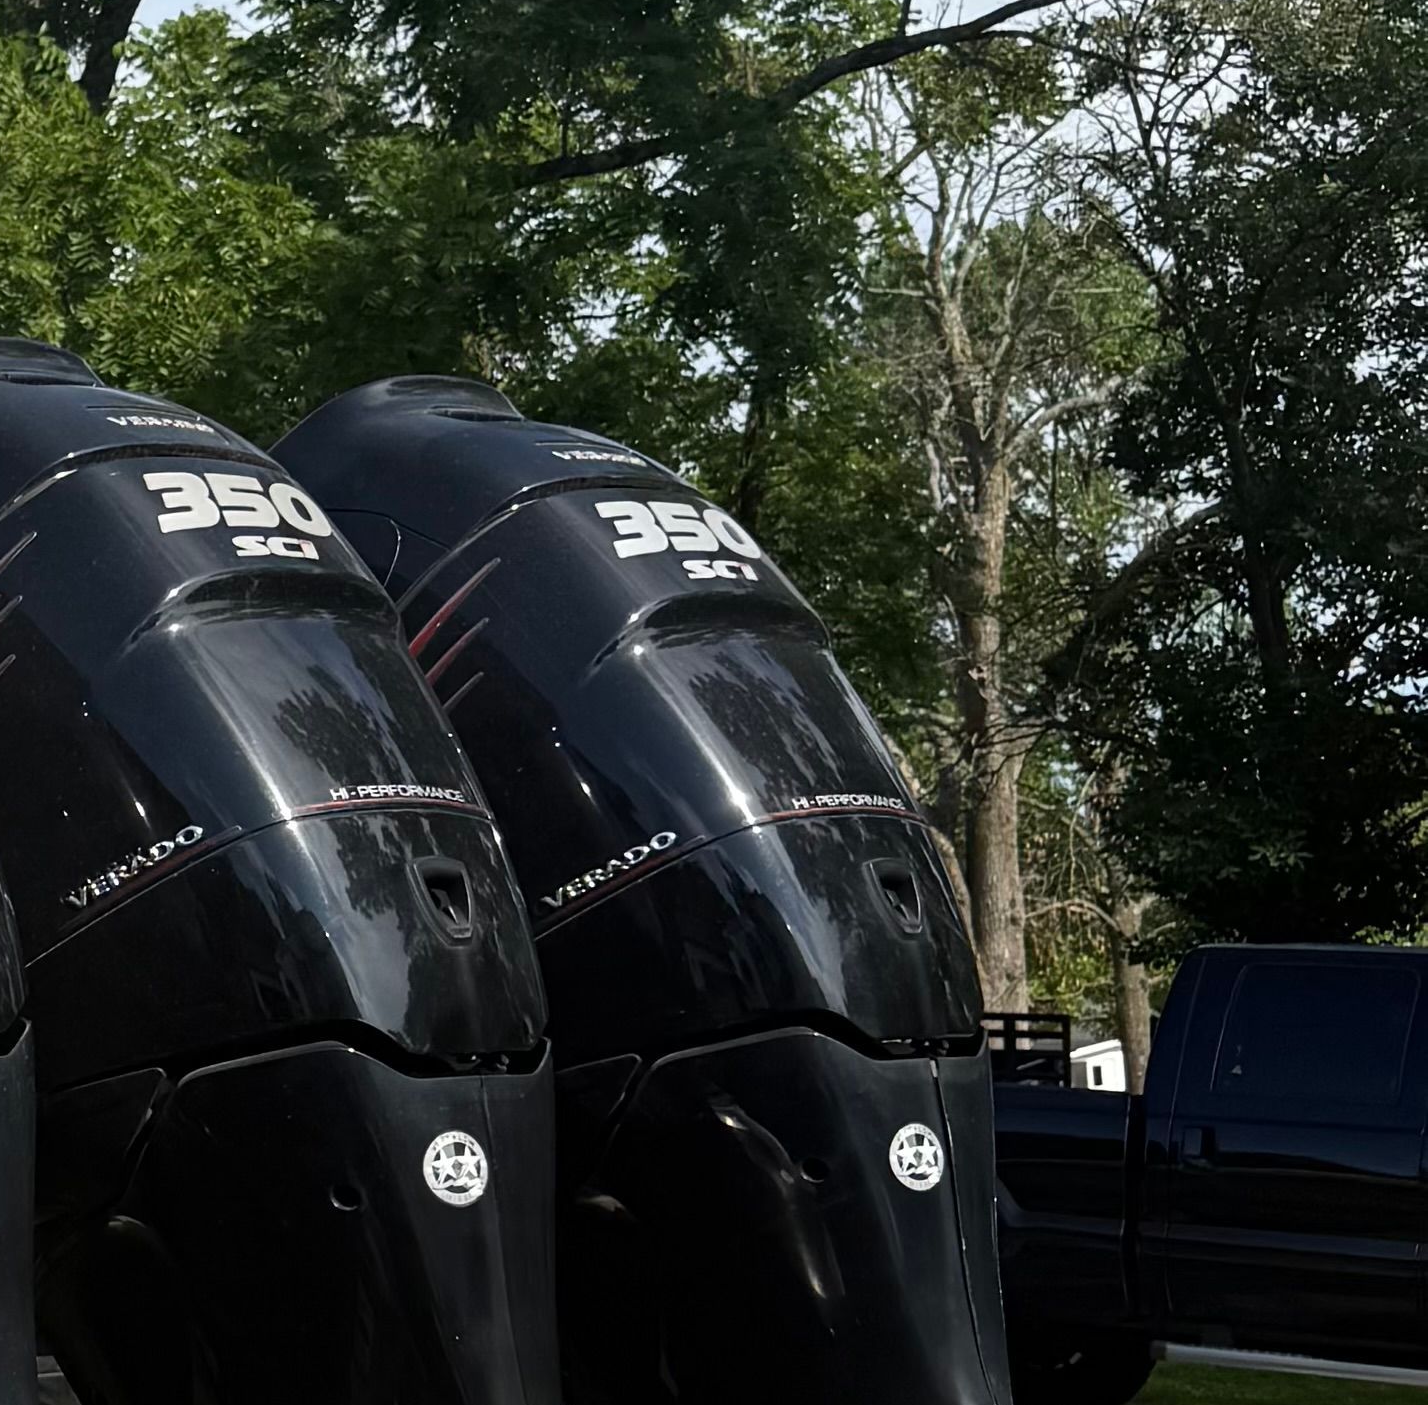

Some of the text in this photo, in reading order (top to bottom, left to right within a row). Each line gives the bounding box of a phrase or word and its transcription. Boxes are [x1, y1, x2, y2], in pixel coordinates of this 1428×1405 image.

[142, 471, 333, 537] 350
[594, 500, 762, 560] 350
[60, 825, 204, 910] VERADO
[542, 830, 678, 910] VERADO
